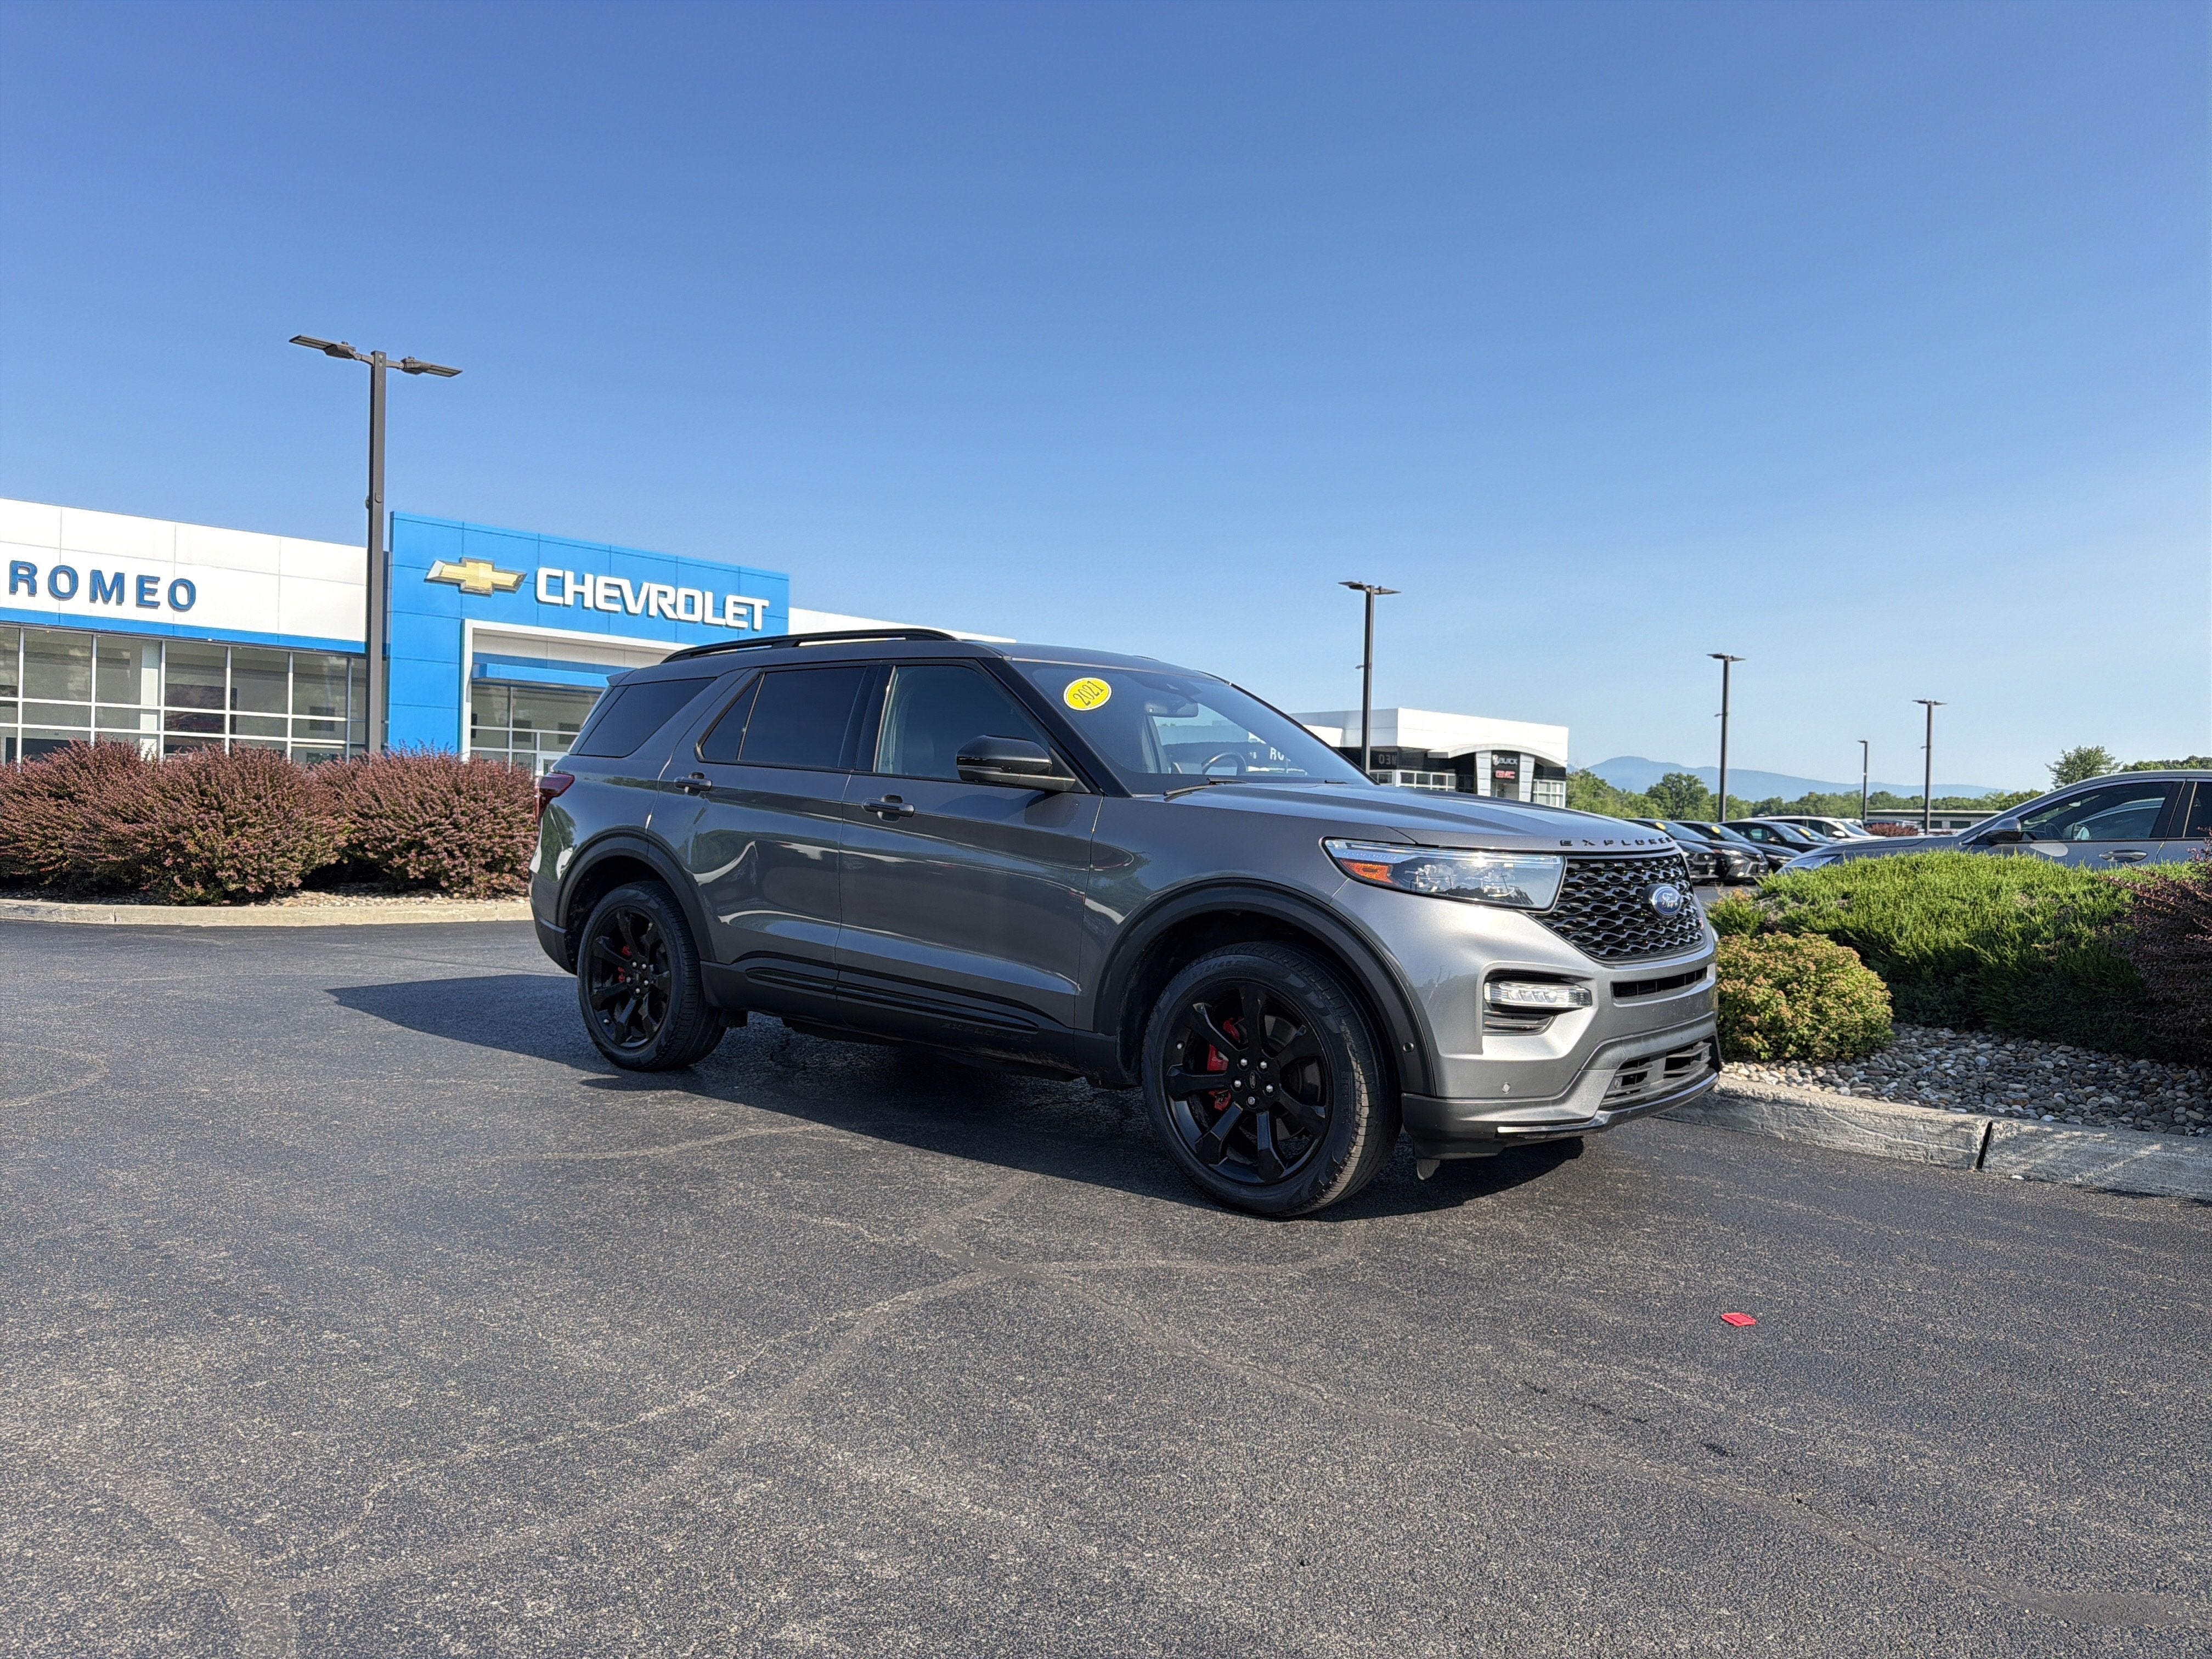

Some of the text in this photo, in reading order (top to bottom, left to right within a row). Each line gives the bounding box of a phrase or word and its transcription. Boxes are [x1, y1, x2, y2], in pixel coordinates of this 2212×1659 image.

[9, 560, 196, 612] ROMEO
[535, 567, 769, 630] CHEVROLET
[1073, 680, 1104, 706] 2021
[1499, 757, 1518, 765] BUICK
[1559, 837, 1673, 847] EXPLORER
[1662, 893, 1679, 909] Ford
